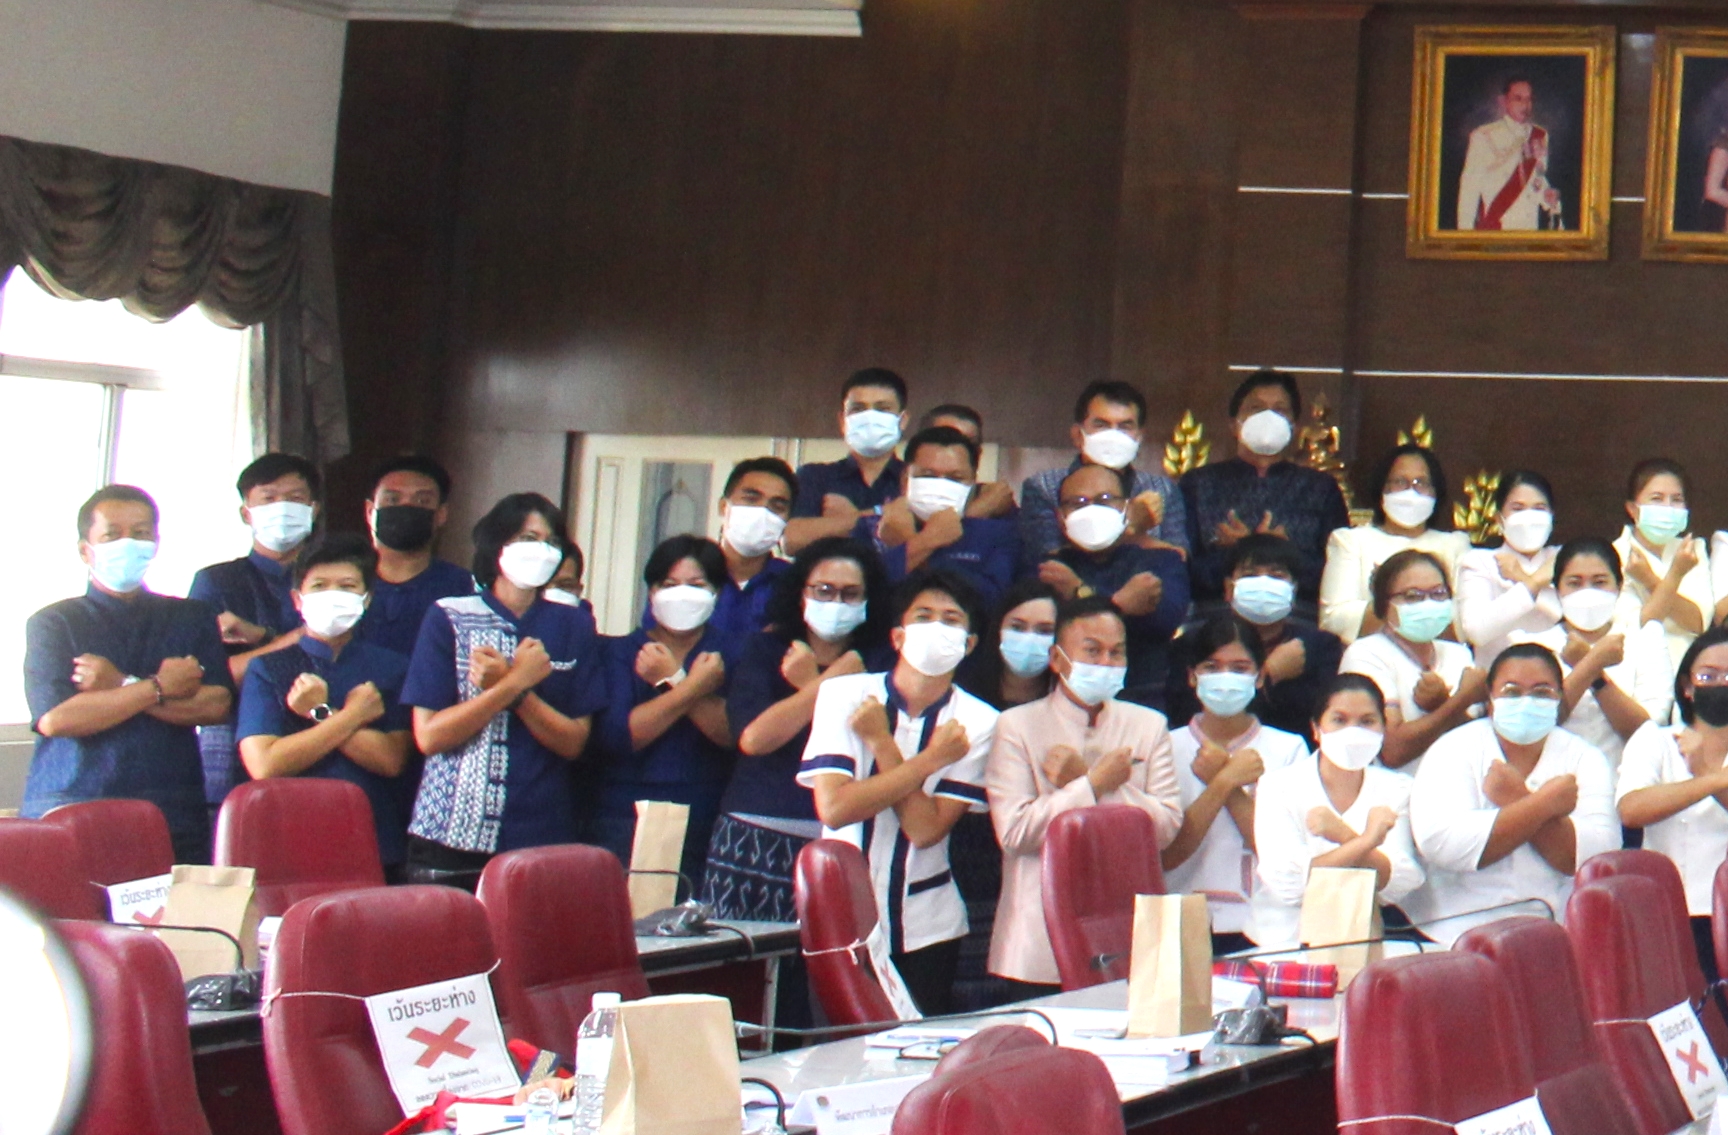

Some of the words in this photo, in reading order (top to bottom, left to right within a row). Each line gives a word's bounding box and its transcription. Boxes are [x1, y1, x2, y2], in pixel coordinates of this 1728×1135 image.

[388, 986, 476, 1022] เว้นระยะห่าง
